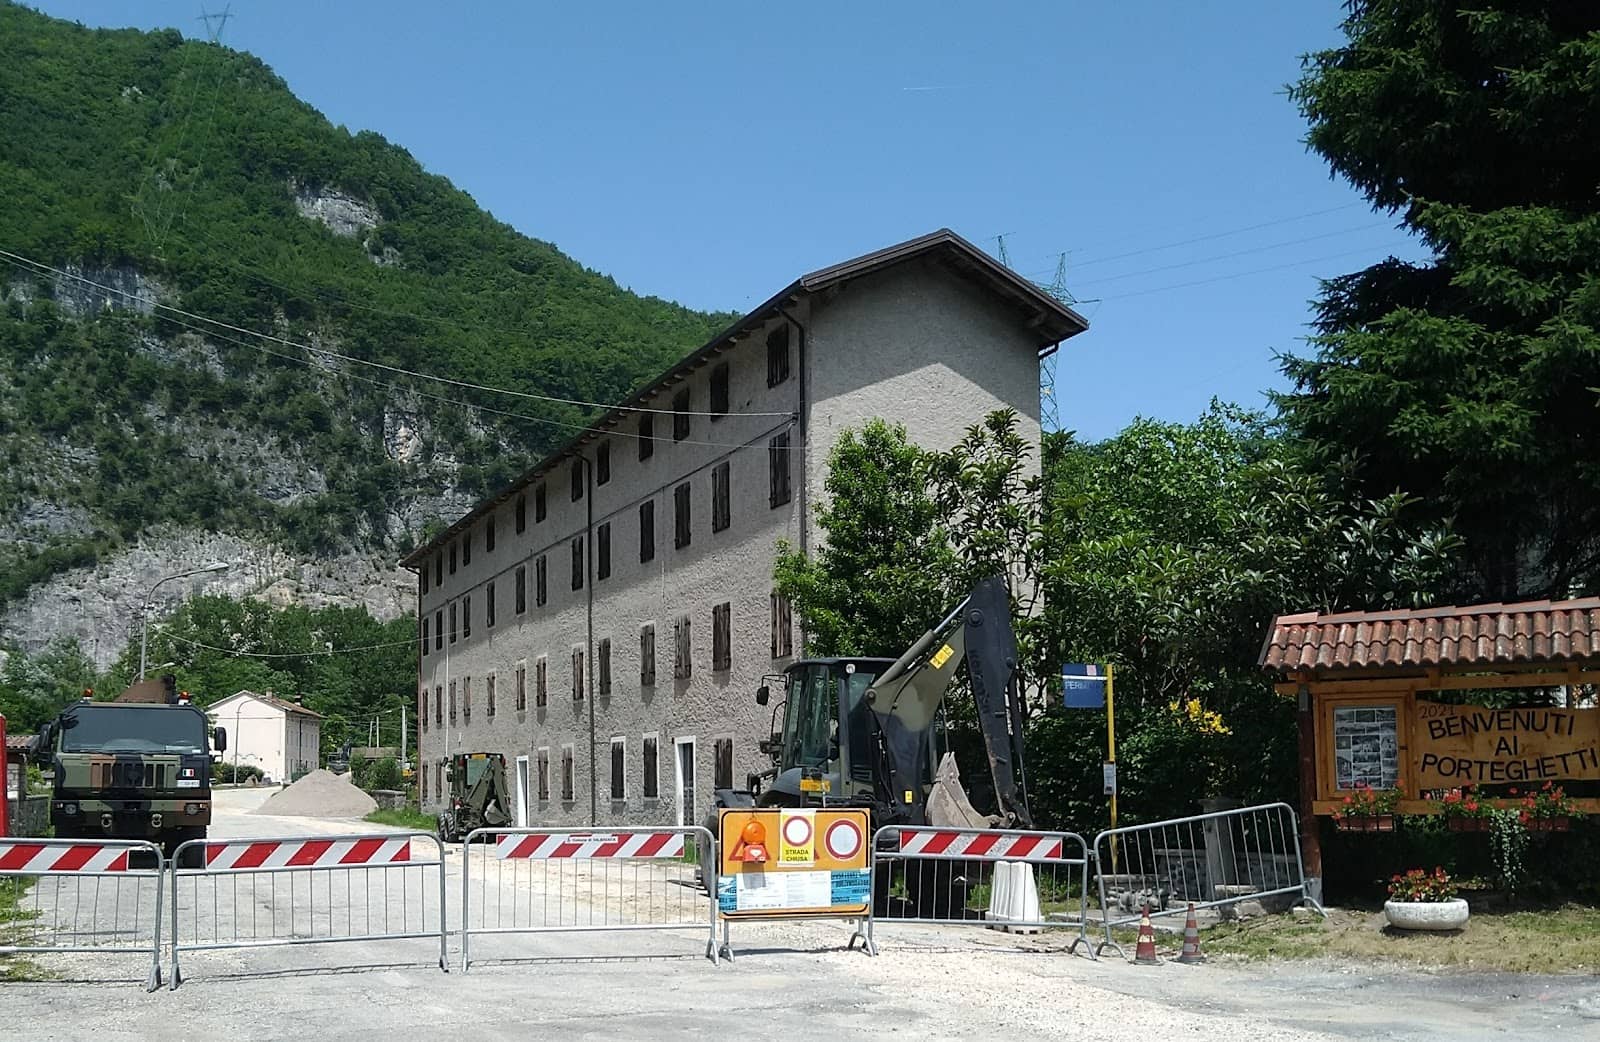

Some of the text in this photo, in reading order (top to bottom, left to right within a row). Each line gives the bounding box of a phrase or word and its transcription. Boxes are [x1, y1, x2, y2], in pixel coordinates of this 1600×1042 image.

[1419, 704, 1454, 718] 2021
[1428, 711, 1574, 739] BENVENUTI
[1495, 736, 1517, 756] AI
[1421, 748, 1598, 780] PORTEGHETTI
